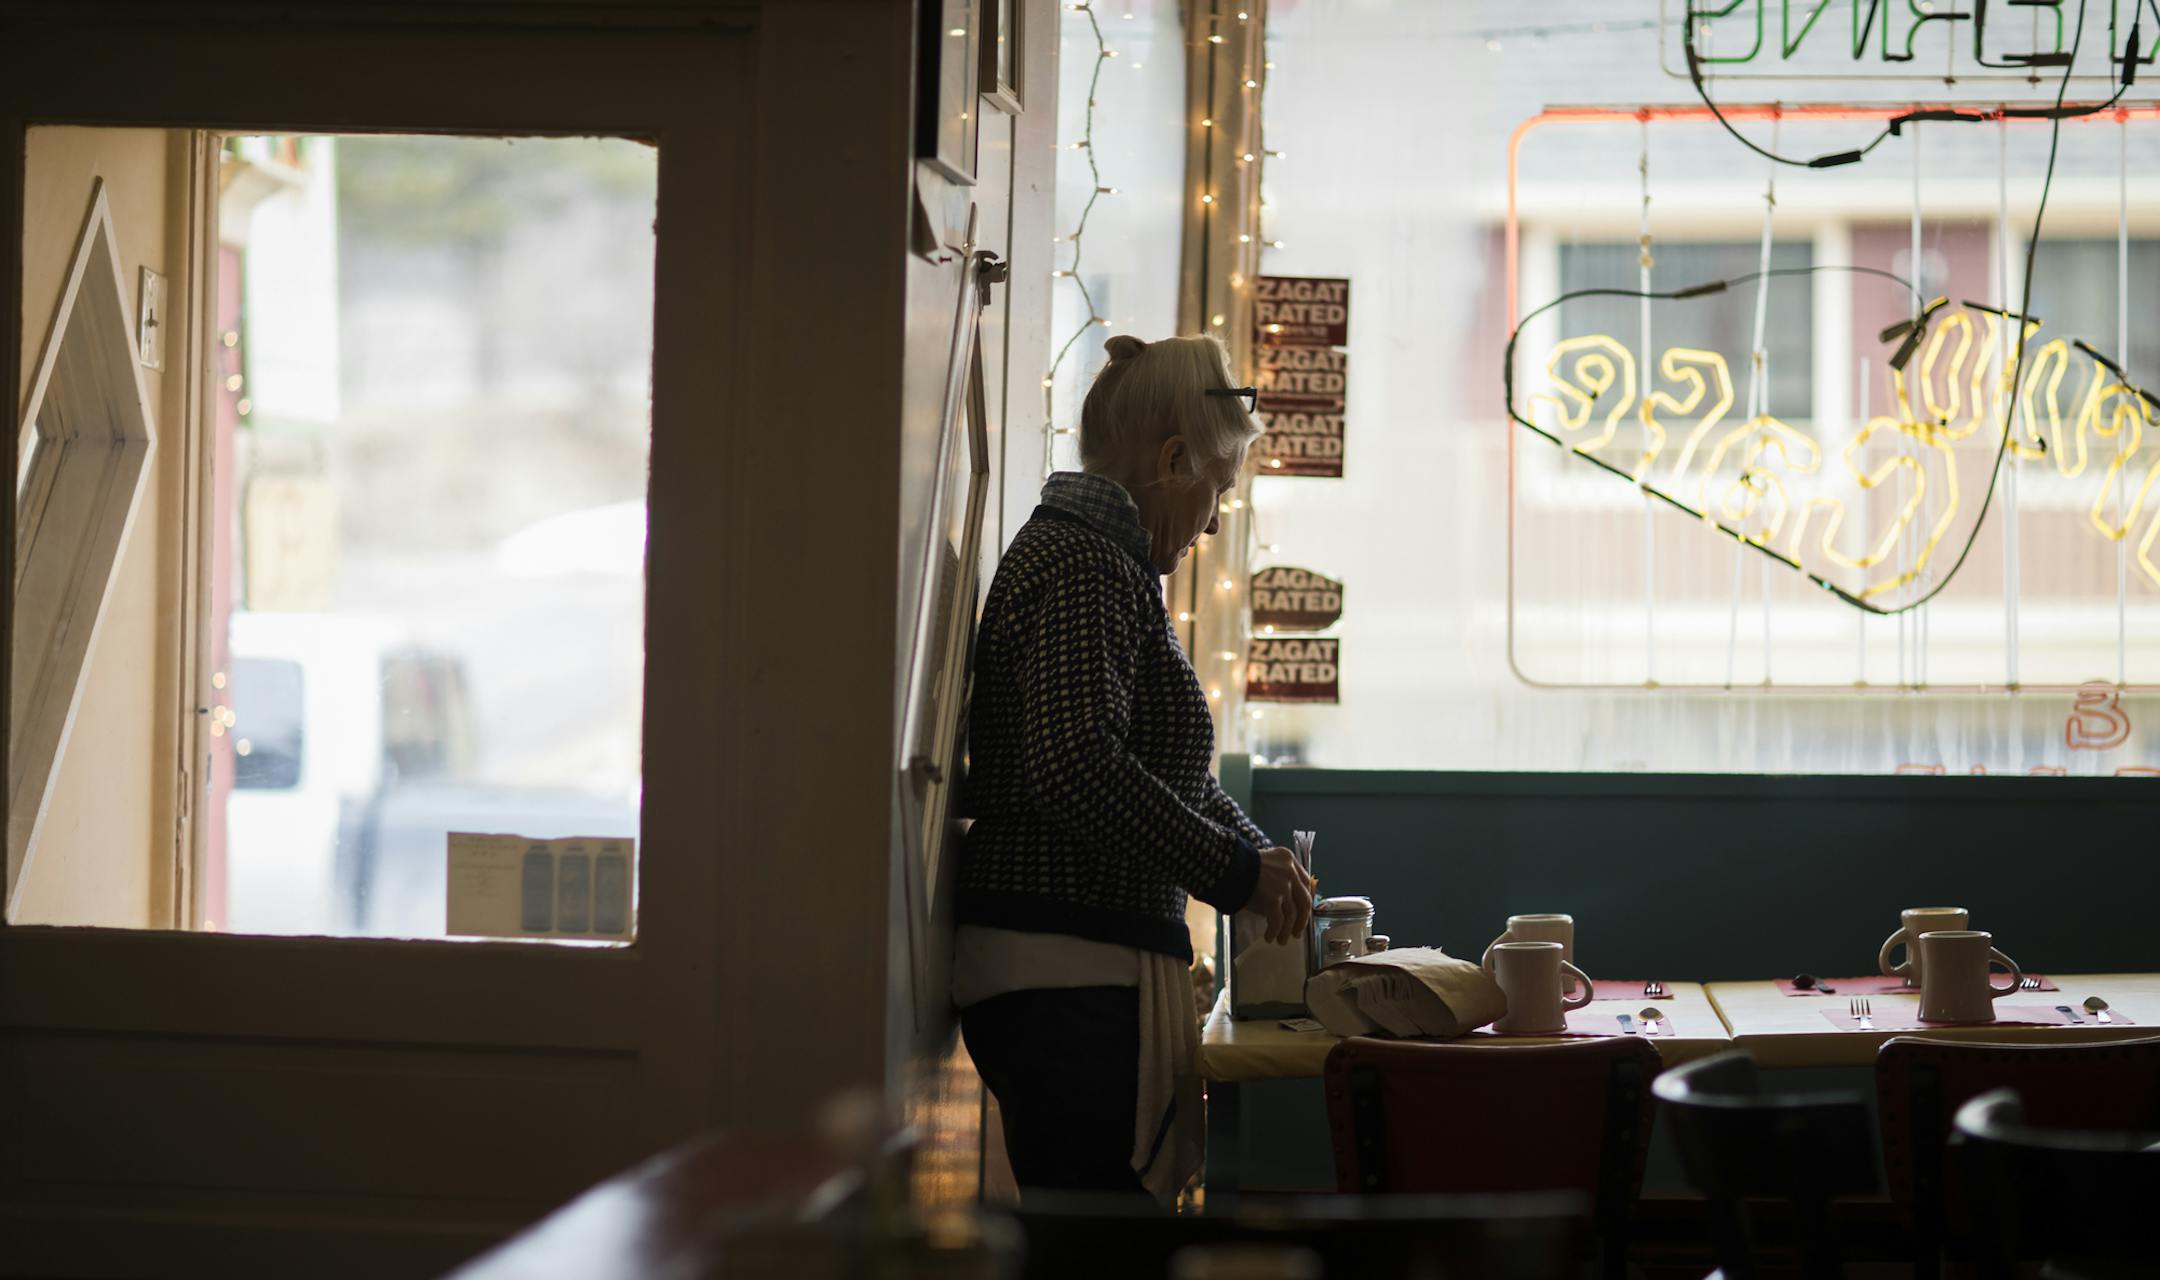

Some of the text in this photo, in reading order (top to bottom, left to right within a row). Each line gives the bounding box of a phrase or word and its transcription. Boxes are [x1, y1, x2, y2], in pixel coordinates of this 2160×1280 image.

[1258, 280, 1346, 302] ZAGAT
[1257, 302, 1345, 325] RATED
[1258, 349, 1344, 371] ZAGAT
[1256, 371, 1344, 393] RATED
[1262, 414, 1343, 434] ZAGAT
[1260, 434, 1342, 457] RATED
[1253, 590, 1340, 612] RATED
[1250, 640, 1336, 661] ZAGAT
[1248, 661, 1337, 683] RATED
